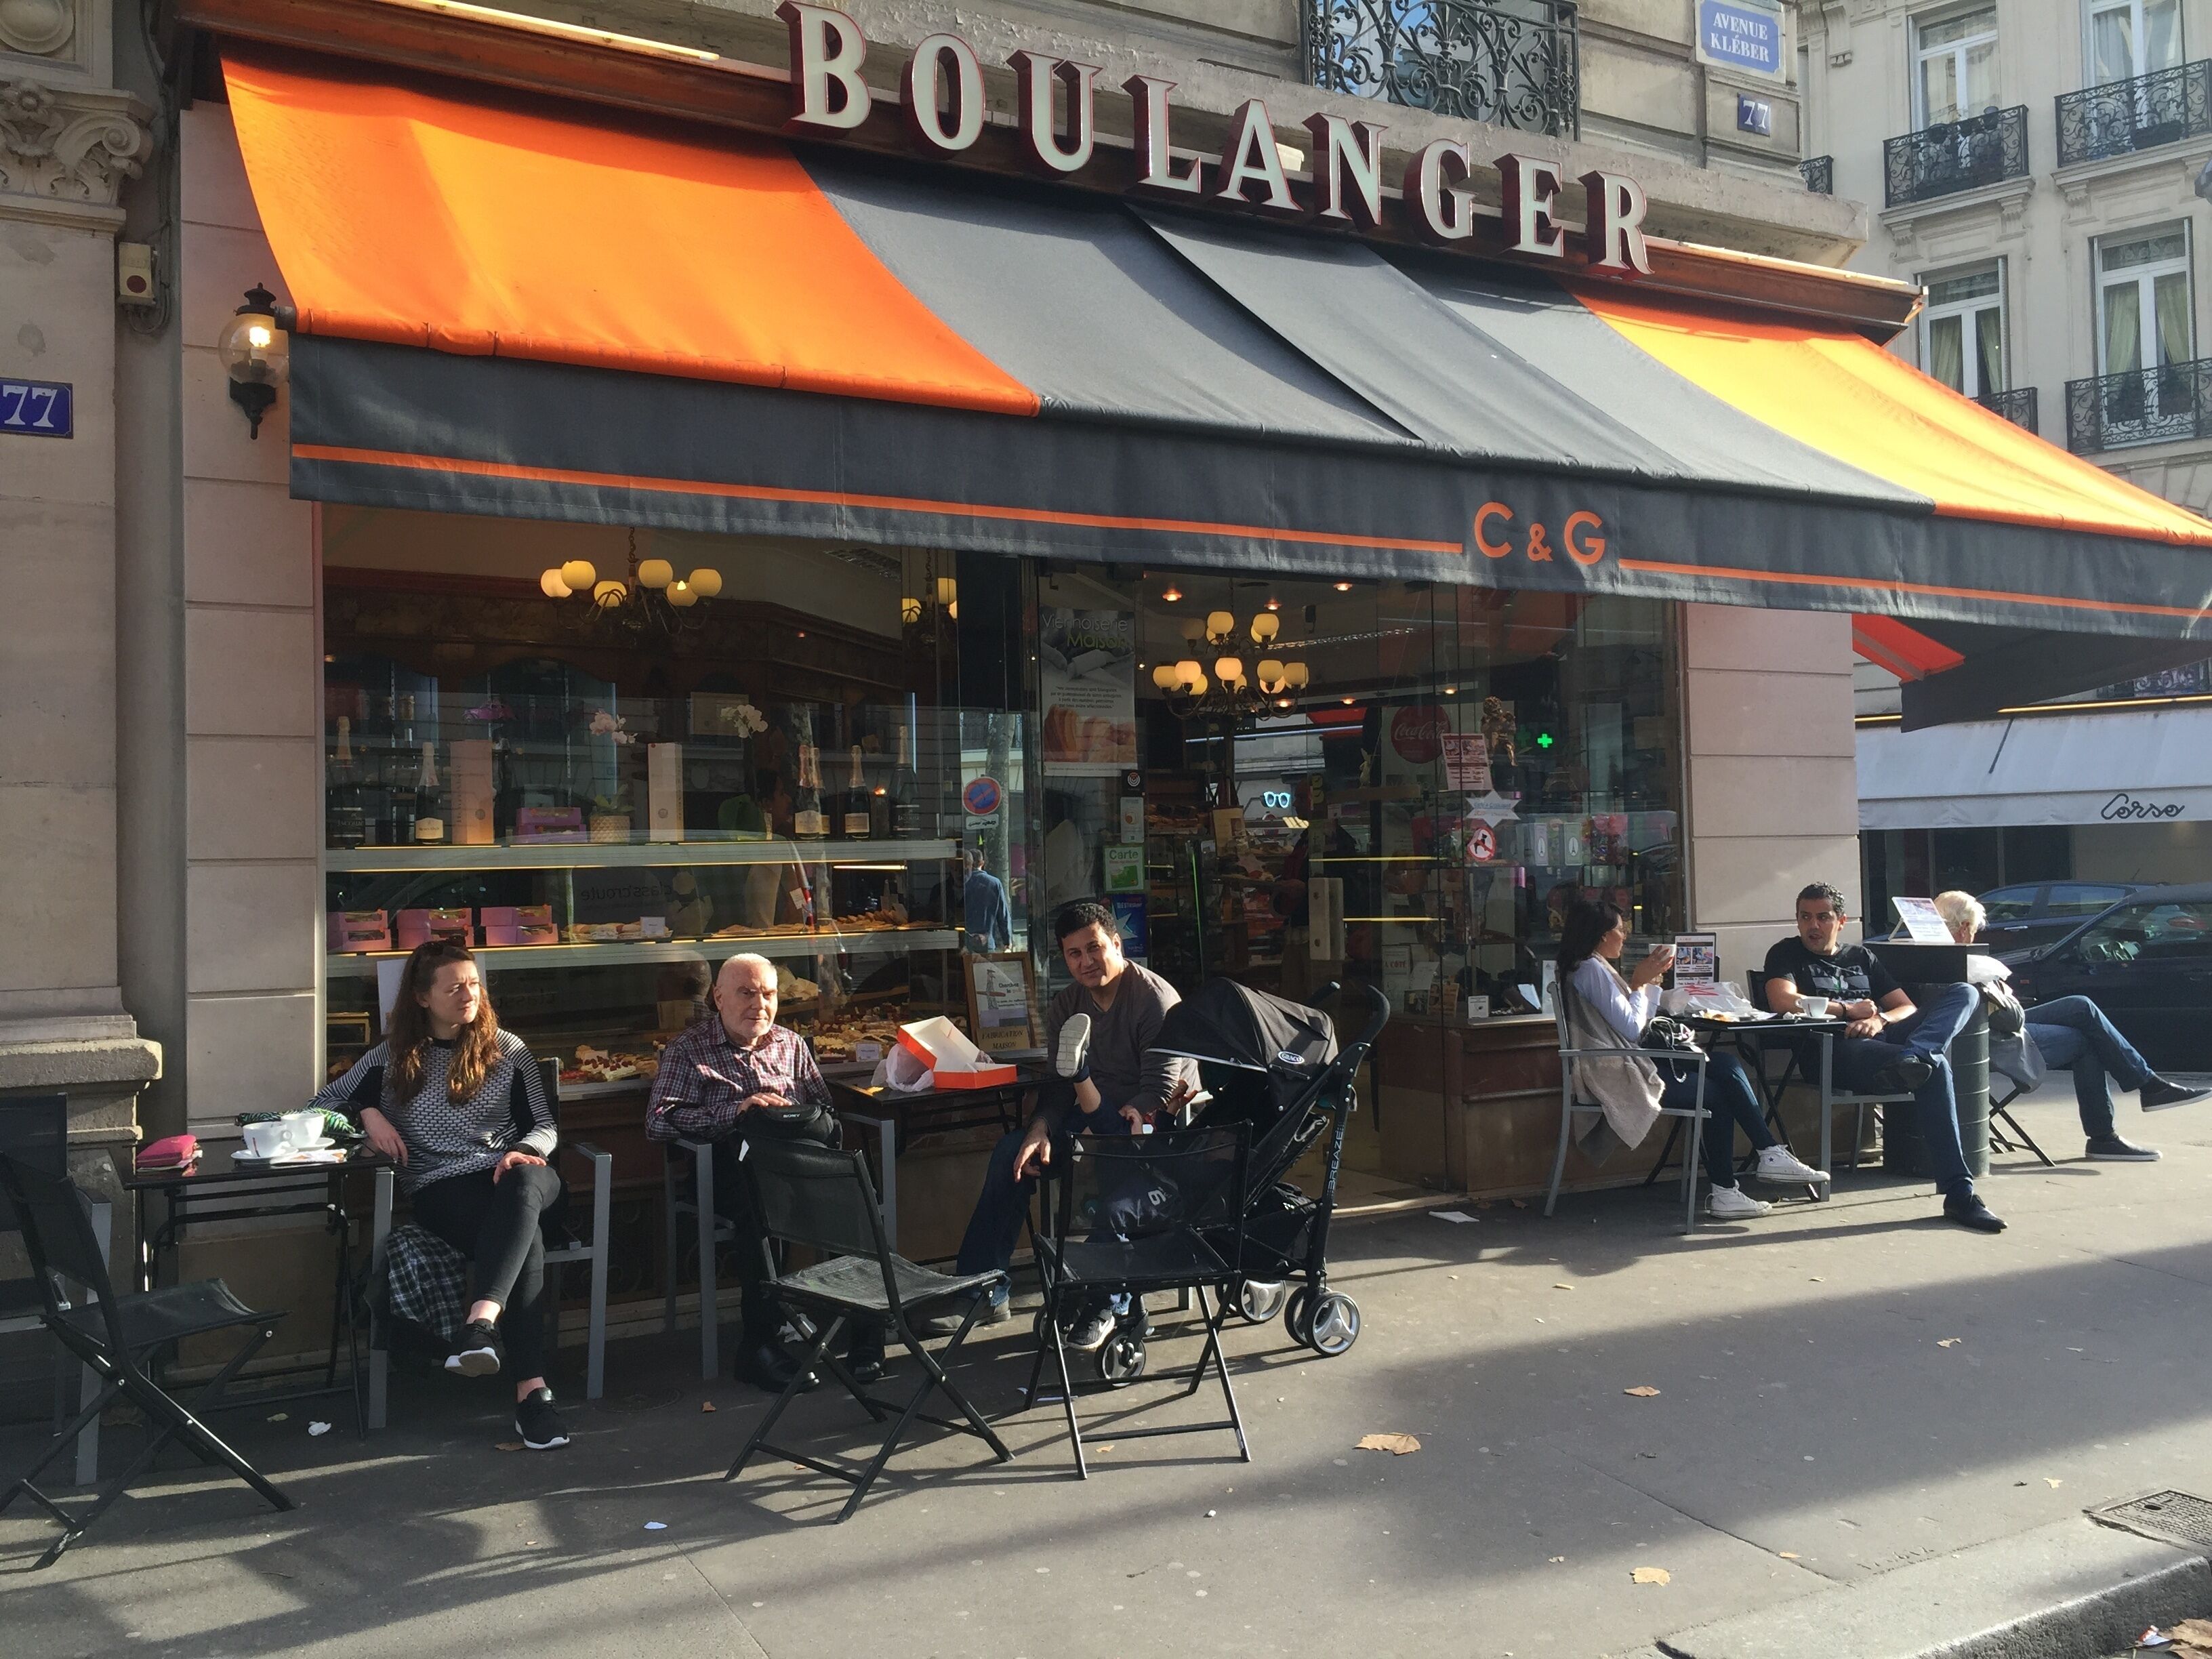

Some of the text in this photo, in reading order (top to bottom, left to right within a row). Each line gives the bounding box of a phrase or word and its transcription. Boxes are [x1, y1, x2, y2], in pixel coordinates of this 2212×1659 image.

[1713, 12, 1768, 41] AVENUE
[1710, 32, 1770, 63] KLÉBER
[1742, 100, 1769, 129] 77
[775, 0, 1655, 274] BOULANGER
[3, 384, 58, 428] 77
[1474, 501, 1605, 565] C & G
[1067, 632, 1128, 649] Maison
[2101, 793, 2185, 820] Corso
[1109, 849, 1139, 860] Carte
[981, 1030, 1023, 1040] FABRICATION
[992, 1041, 1016, 1049] MAISON
[1281, 1052, 1303, 1063] GRACO
[1328, 1130, 1345, 1191] BREAZE
